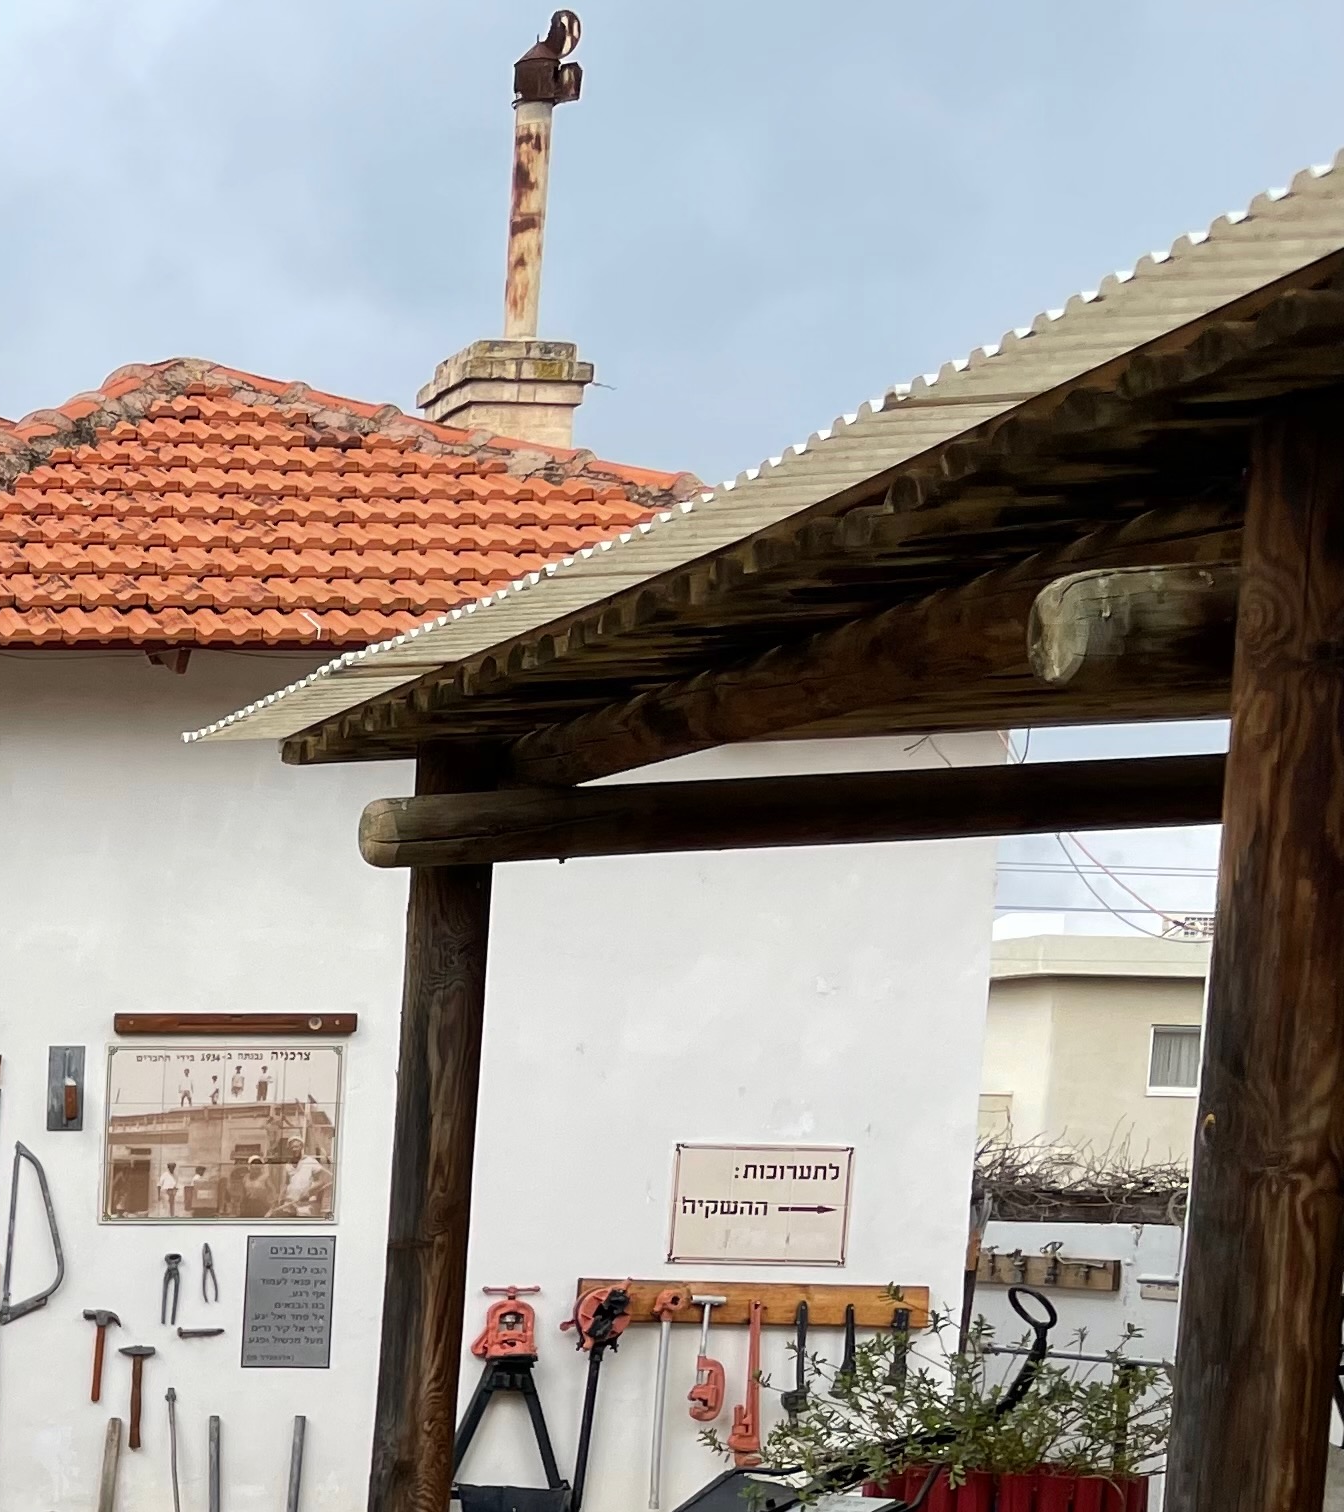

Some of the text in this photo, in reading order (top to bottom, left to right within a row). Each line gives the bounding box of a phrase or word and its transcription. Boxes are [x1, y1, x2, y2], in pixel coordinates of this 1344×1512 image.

[270, 1051, 311, 1061] צרכניה
[734, 1163, 840, 1181] לתערוכות:
[682, 1196, 768, 1219] ההשקיה
[269, 1244, 303, 1255] לבנים
[281, 1265, 308, 1275] לבנים
